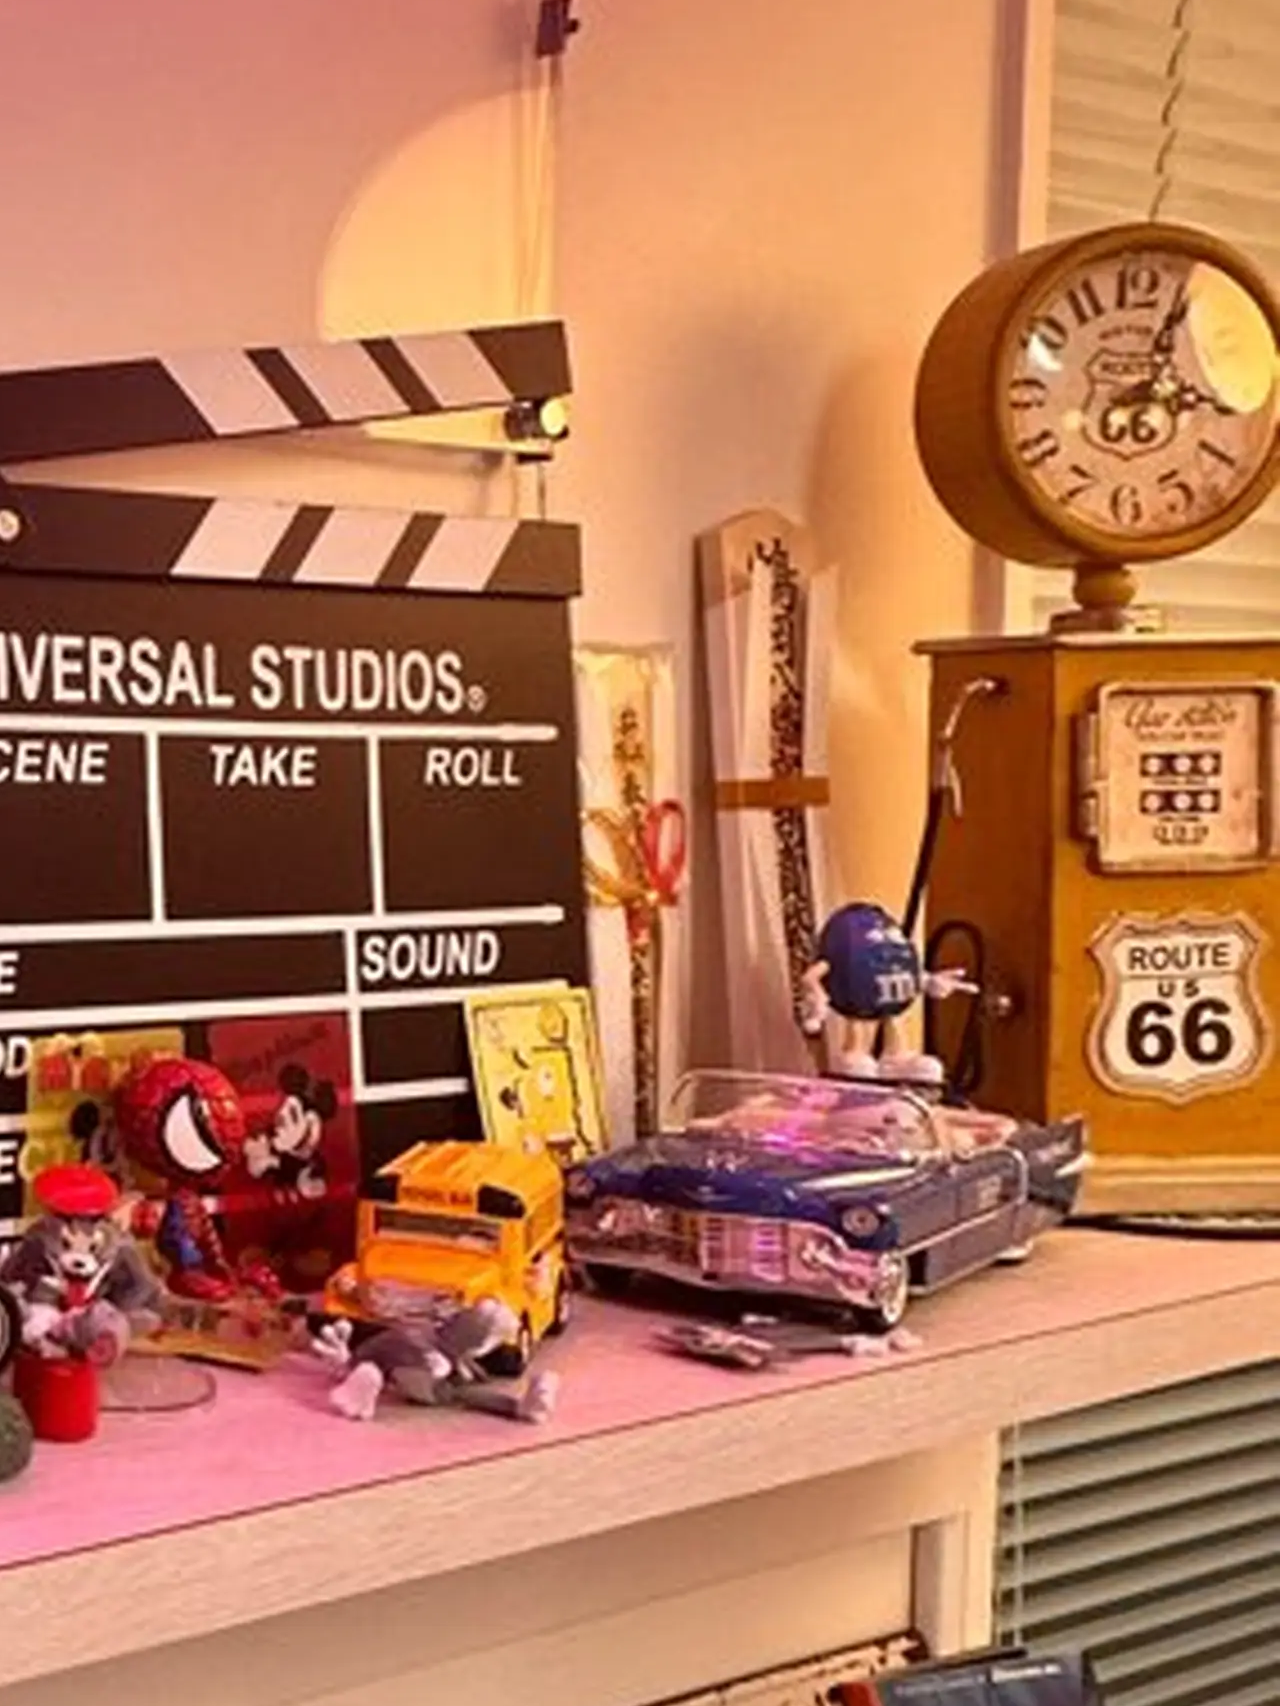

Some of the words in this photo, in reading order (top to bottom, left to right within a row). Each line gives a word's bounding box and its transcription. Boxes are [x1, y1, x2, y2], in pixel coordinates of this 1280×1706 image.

[1116, 267, 1159, 311] 12
[208, 745, 318, 786] TAKE
[425, 747, 522, 787] ROLL
[360, 930, 500, 980] SOUND
[1126, 941, 1232, 971] ROUTE
[1125, 997, 1235, 1068] 66
